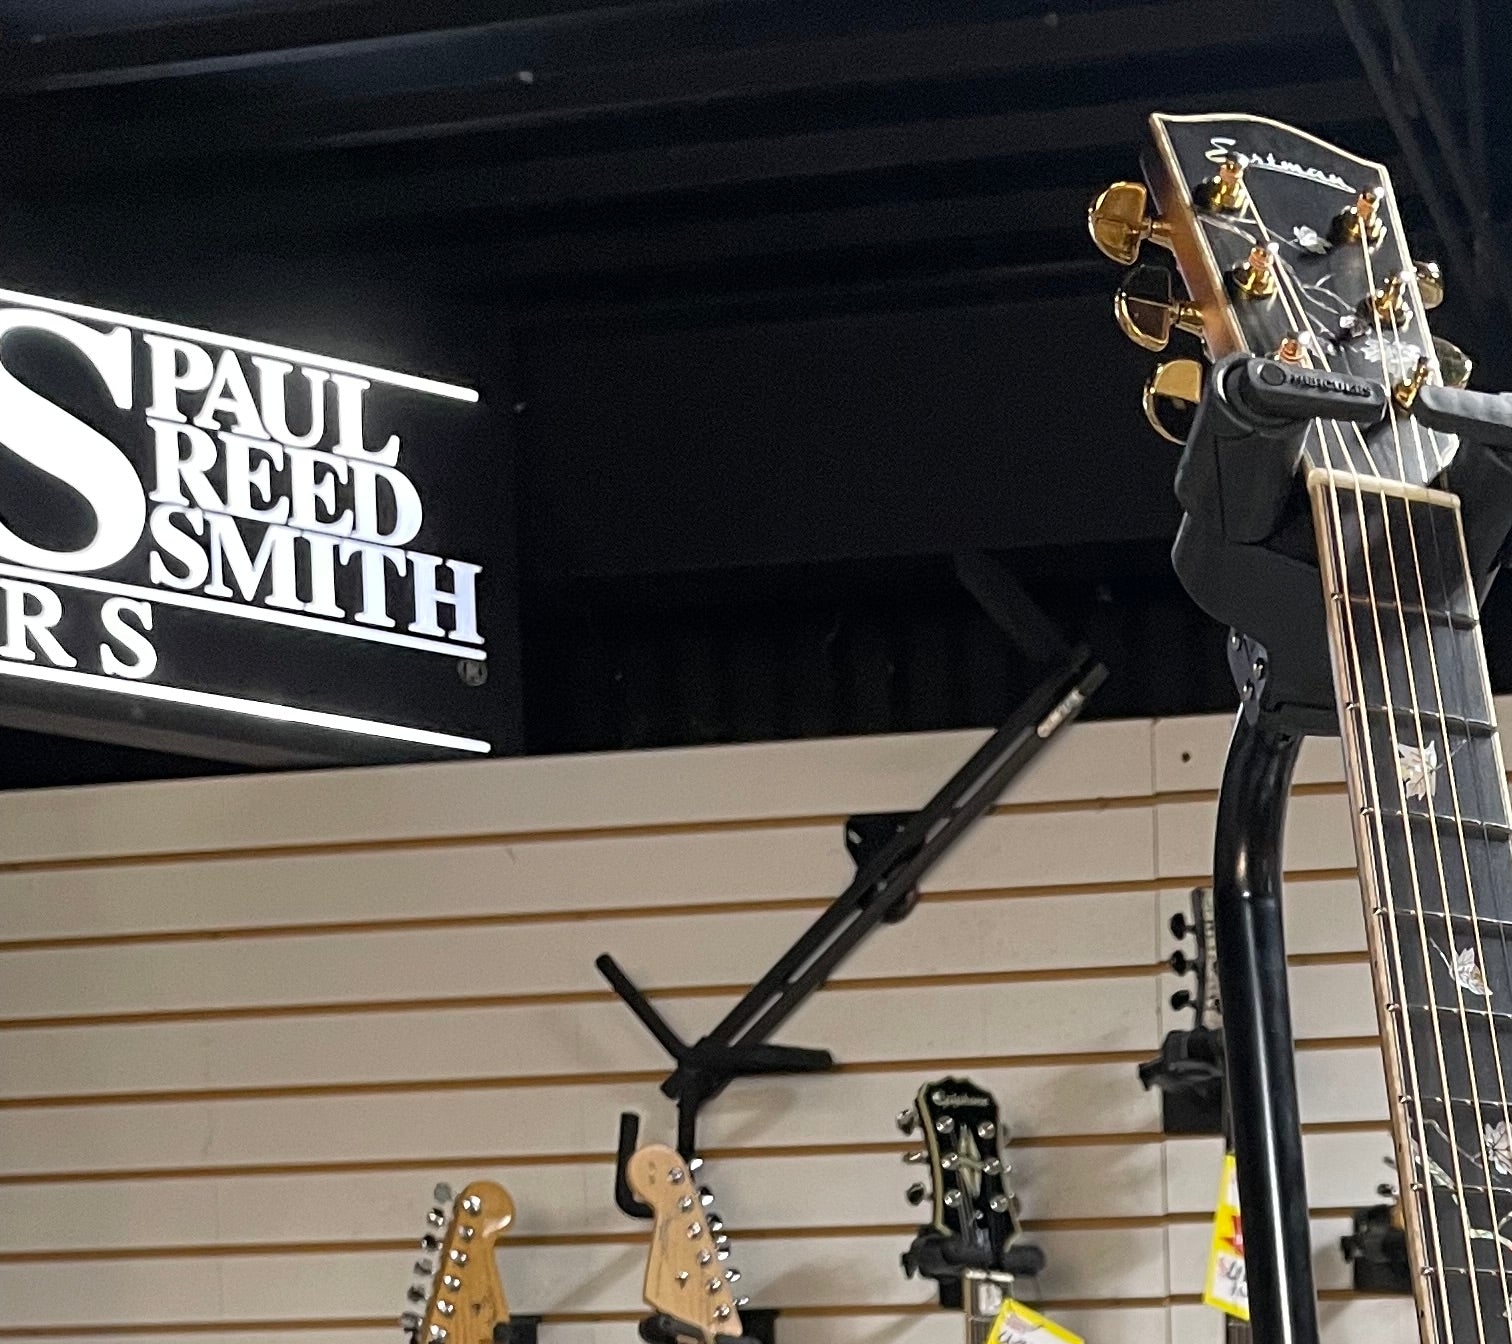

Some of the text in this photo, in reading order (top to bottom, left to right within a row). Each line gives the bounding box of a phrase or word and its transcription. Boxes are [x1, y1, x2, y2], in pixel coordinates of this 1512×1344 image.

[142, 333, 400, 466] PAUL
[146, 418, 423, 547] REED
[149, 505, 484, 645] SMITH
